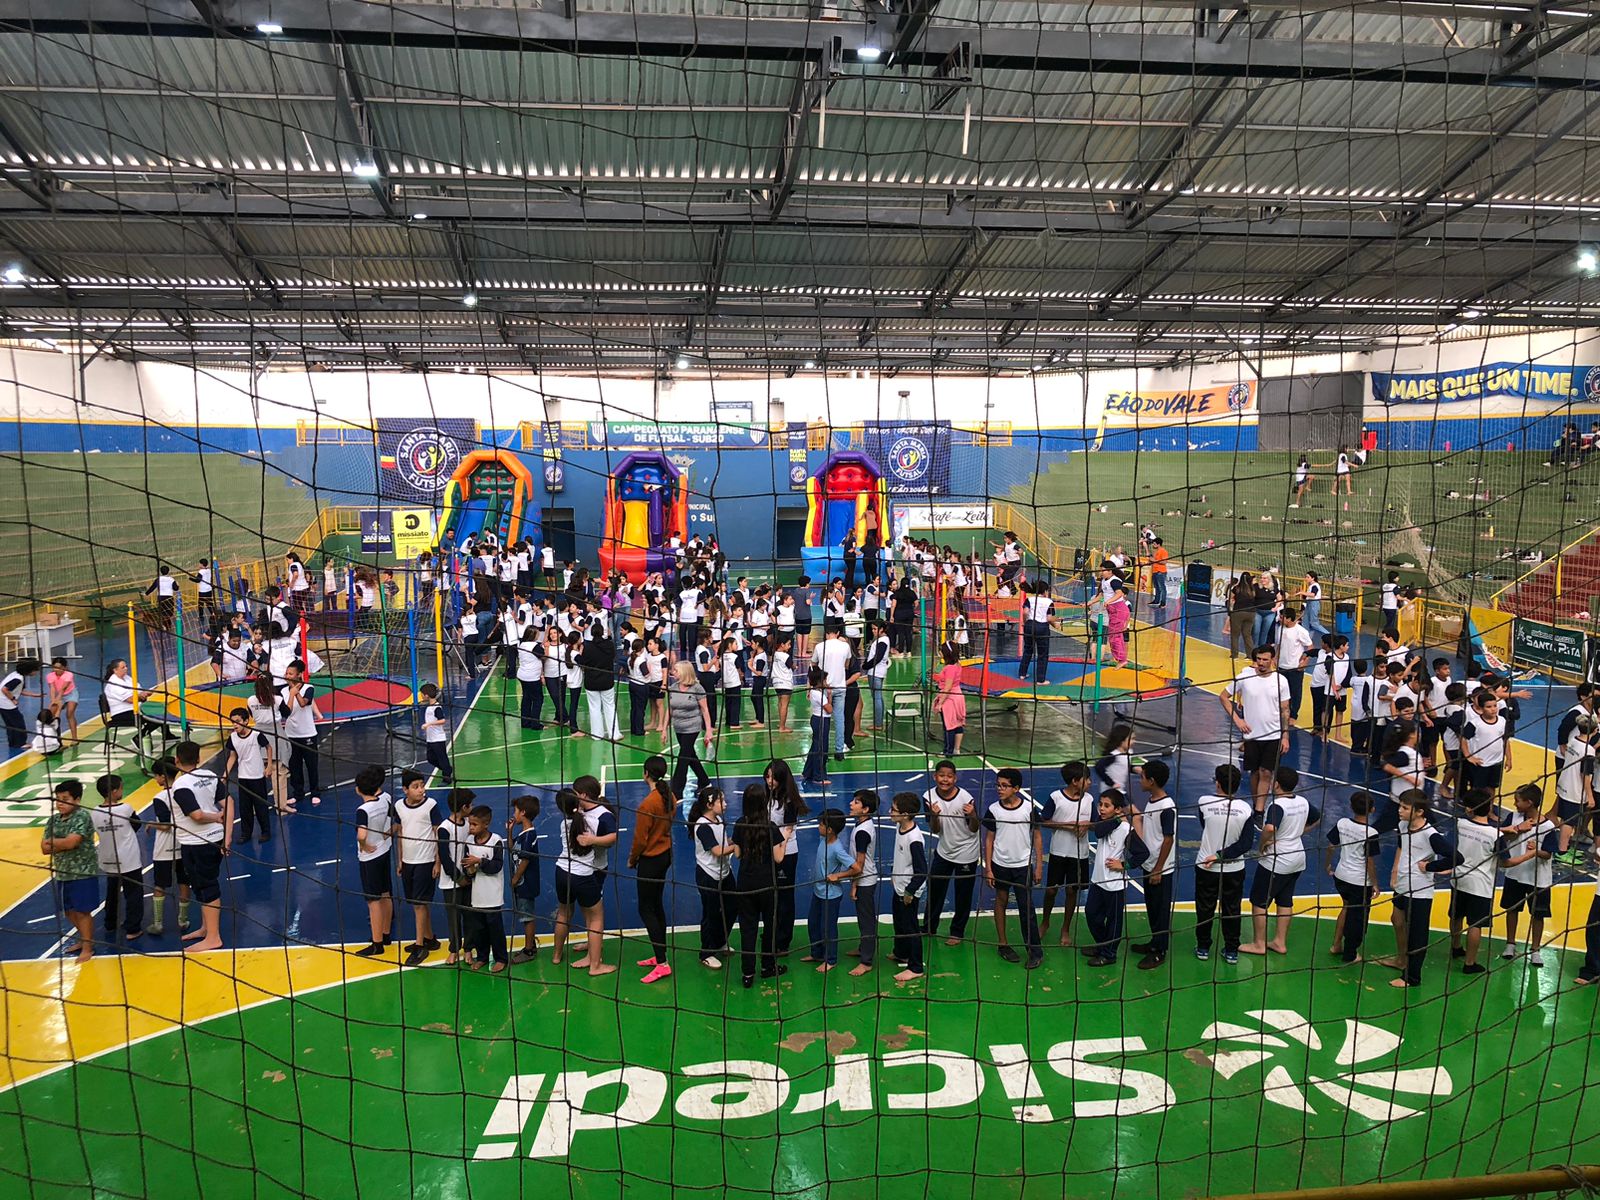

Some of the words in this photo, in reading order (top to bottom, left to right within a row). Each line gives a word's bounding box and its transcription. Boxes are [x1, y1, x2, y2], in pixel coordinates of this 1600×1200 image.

[1389, 377, 1439, 400] MAIS
[1442, 373, 1482, 400] QUE
[1487, 367, 1519, 393] UM
[1523, 369, 1579, 396] TIME.
[1163, 392, 1215, 416] VALE
[613, 425, 679, 435] CAMPEONATO
[681, 425, 745, 435] PARANAENSE
[634, 433, 650, 443] DE
[651, 433, 685, 443] FUTSAL
[692, 434, 724, 443] SUB20
[400, 433, 427, 459] SANTA
[429, 433, 457, 460] MARIA
[891, 440, 909, 460] SANTA
[910, 440, 927, 460] MARIA
[408, 473, 450, 488] FUTSAL
[896, 468, 922, 479] FUTSAL
[927, 510, 952, 524] Café
[962, 510, 990, 525] Leite
[397, 530, 429, 538] missiato
[472, 1036, 1176, 1163] Sicredi
